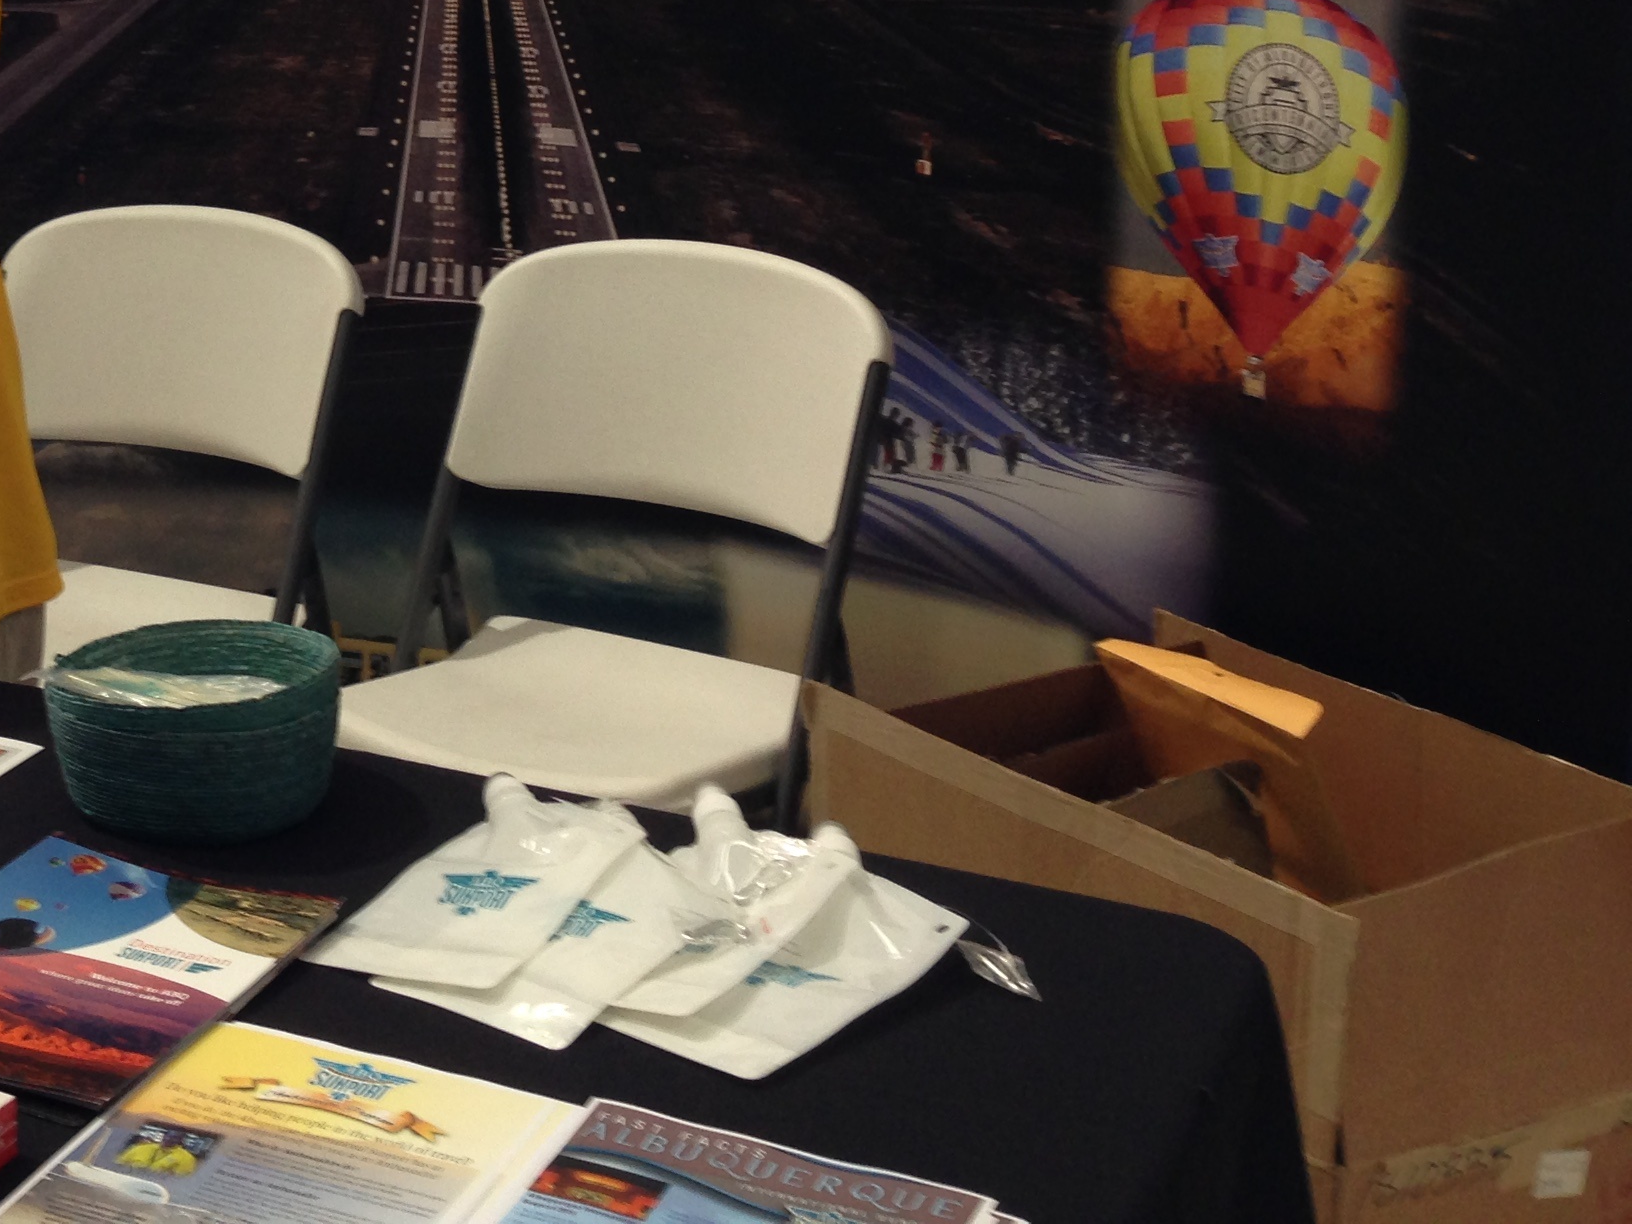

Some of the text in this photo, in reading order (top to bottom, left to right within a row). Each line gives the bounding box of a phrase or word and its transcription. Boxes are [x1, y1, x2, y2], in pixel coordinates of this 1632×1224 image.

[437, 885, 516, 910] SUNPORT
[115, 946, 185, 972] SUNPORT
[127, 938, 233, 967] Destination
[309, 1069, 392, 1101] SUNPORT
[595, 1110, 769, 1161] FAST FACTS
[580, 1122, 965, 1221] ALBUQUERQUE
